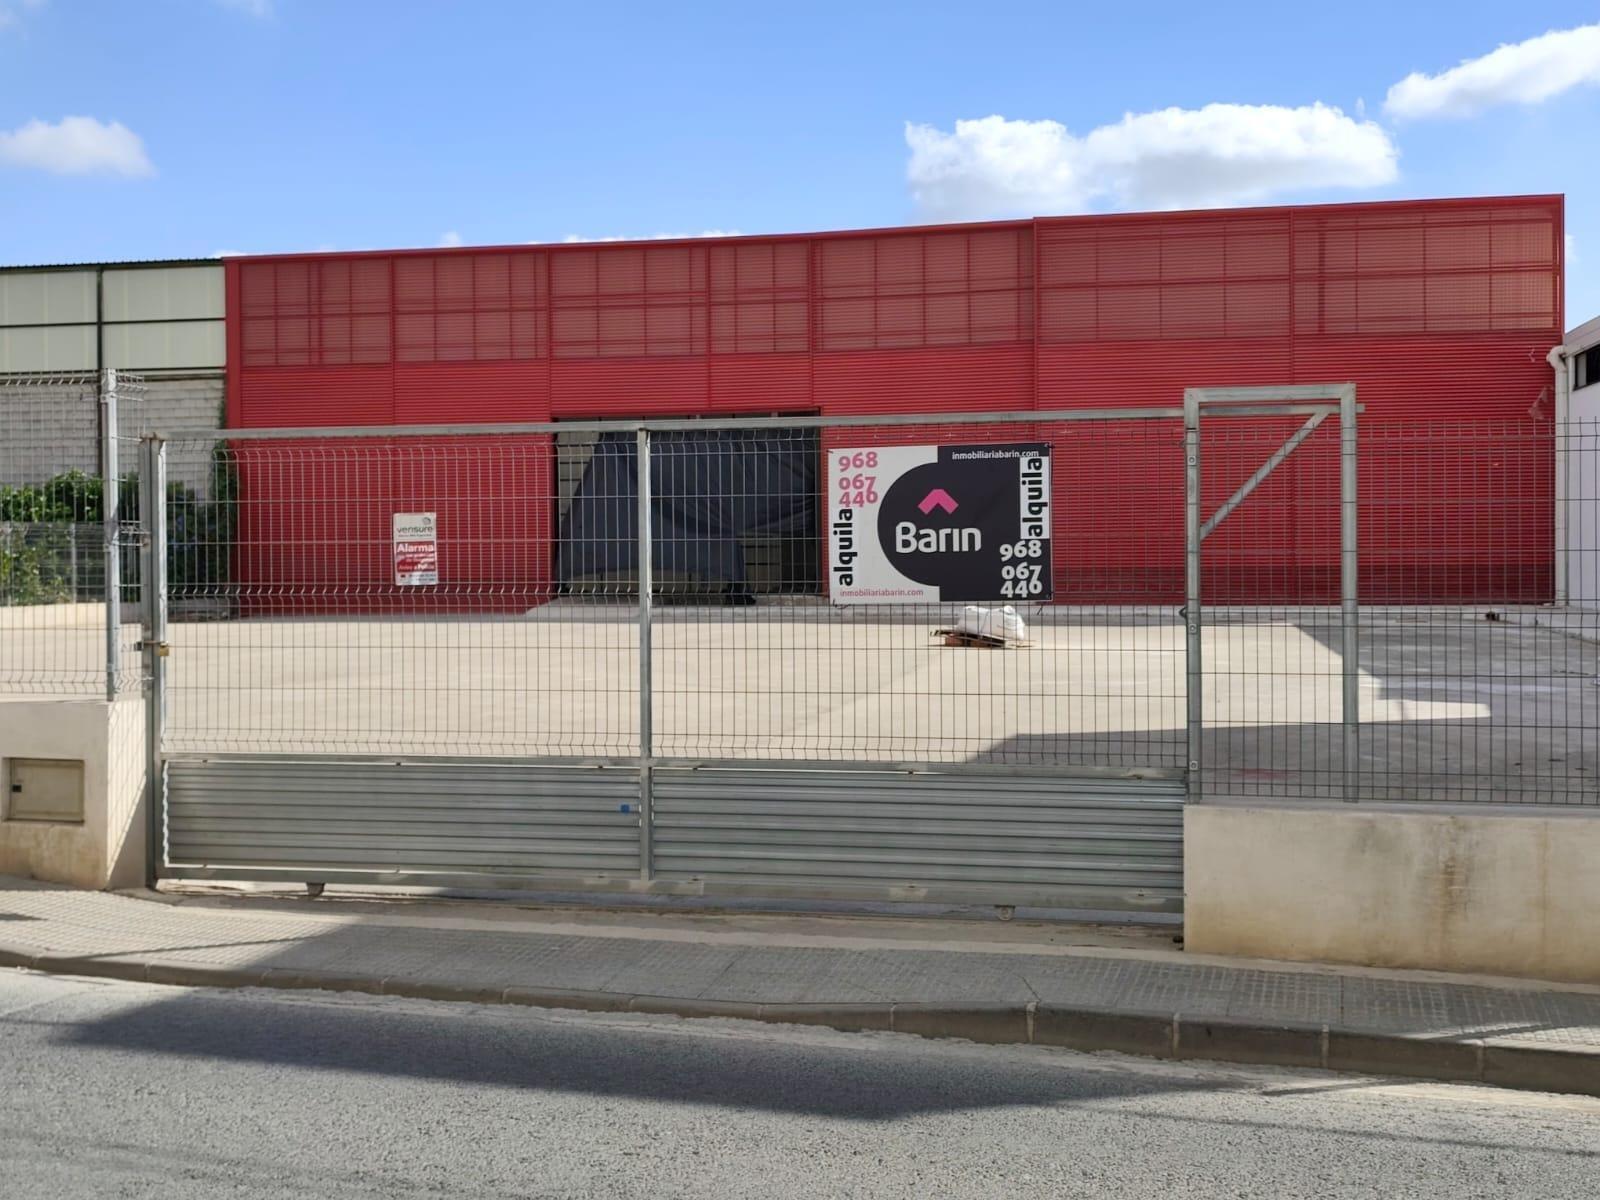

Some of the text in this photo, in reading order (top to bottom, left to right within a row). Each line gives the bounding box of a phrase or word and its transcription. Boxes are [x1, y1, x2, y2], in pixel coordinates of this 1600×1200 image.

[838, 451, 878, 472] 968
[952, 450, 1039, 460] inmobiliariabarin.com
[838, 473, 877, 495] 067
[1022, 458, 1048, 537] alquila
[397, 543, 434, 553] Alarma
[833, 508, 858, 586] alquila
[895, 521, 982, 554] Barin
[999, 540, 1042, 562] 968
[1001, 562, 1043, 585] 067
[840, 587, 924, 597] inmobiliariabarin.com
